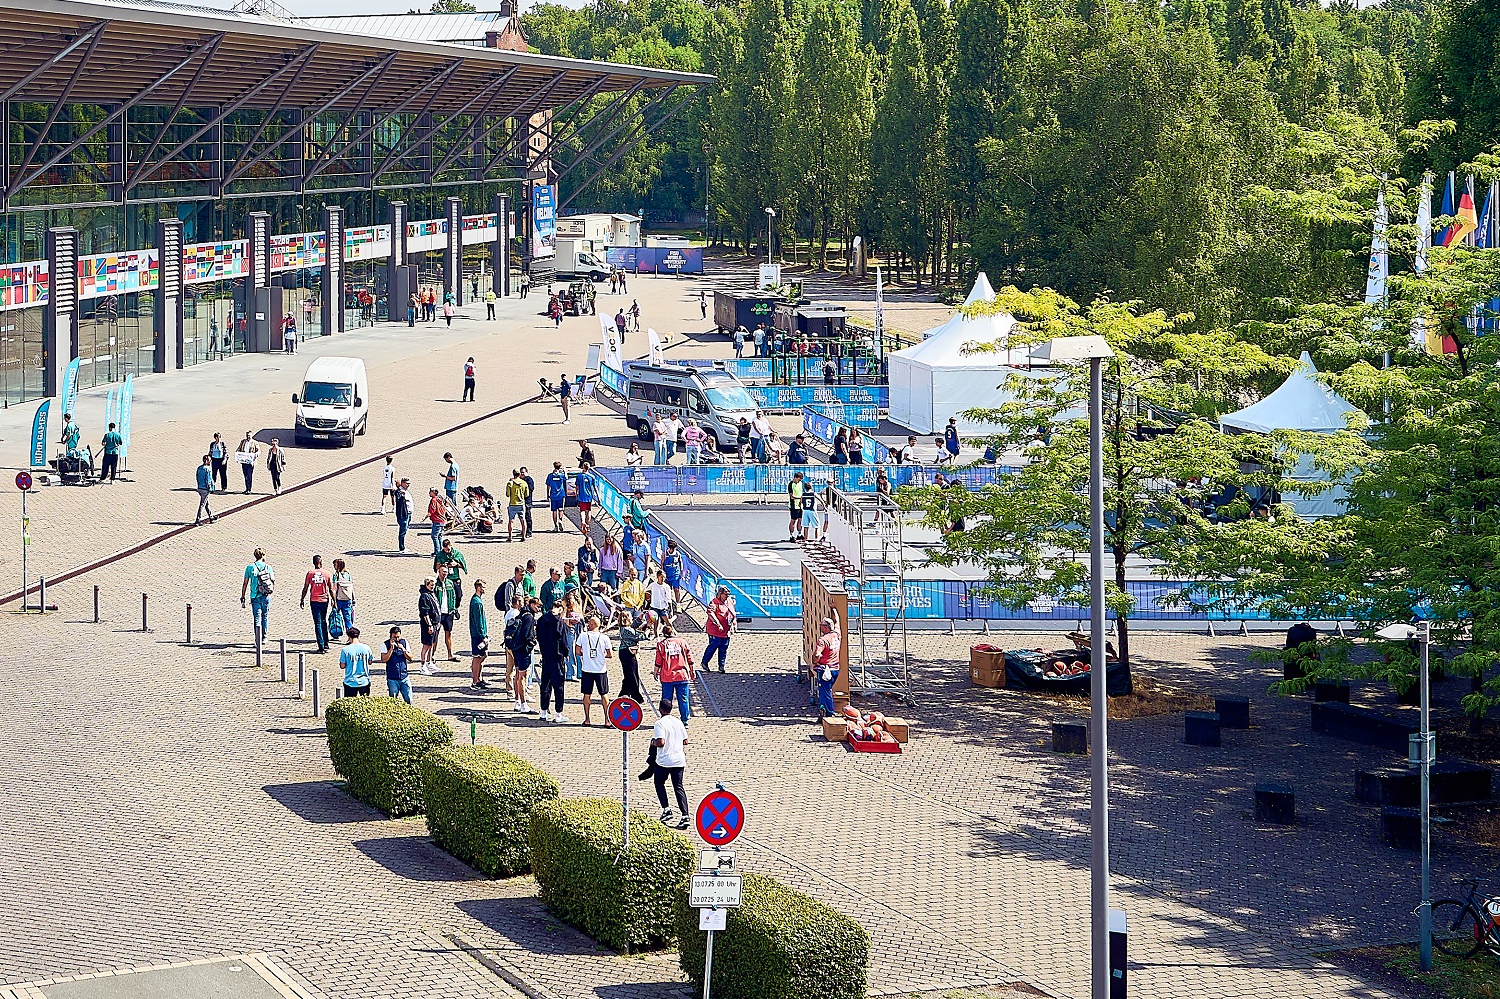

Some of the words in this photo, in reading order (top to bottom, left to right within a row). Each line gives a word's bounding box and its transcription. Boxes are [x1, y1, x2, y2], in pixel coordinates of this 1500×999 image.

[67, 367, 77, 396] GAMES
[37, 411, 47, 442] GAMES
[34, 443, 44, 465] RUHR
[760, 586, 792, 597] RUHR
[760, 596, 801, 607] GAMES
[889, 596, 932, 608] GAMES
[716, 880, 725, 888] 00
[726, 880, 737, 888] Uhr
